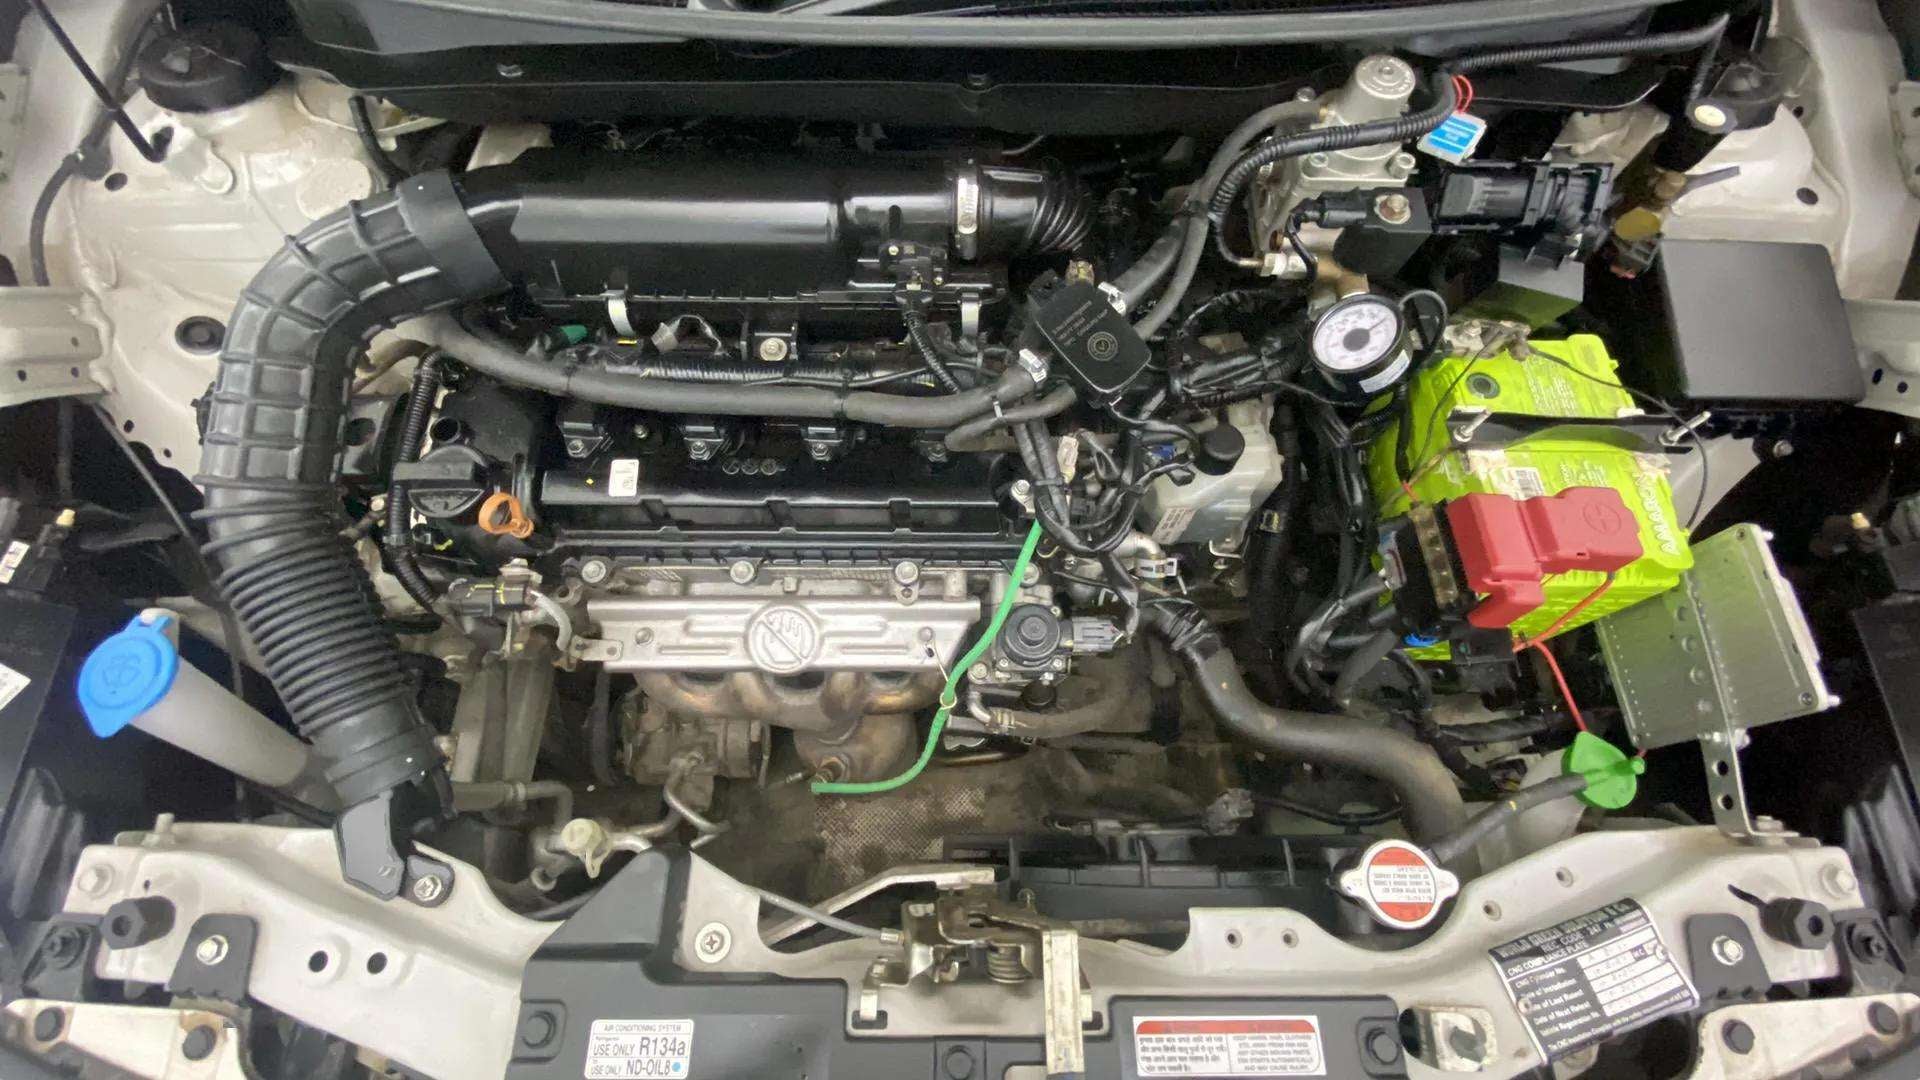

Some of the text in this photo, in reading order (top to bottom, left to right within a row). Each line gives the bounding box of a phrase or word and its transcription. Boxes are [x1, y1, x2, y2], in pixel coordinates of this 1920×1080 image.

[1506, 964, 1523, 976] CNG
[1521, 947, 1568, 970] COMPLIANCE
[1565, 939, 1589, 954] PLATE
[603, 1024, 681, 1032] AIR CONDITIONING SYSTEM
[593, 1036, 686, 1056] USE ONLY R134a
[591, 1065, 604, 1076] USE
[606, 1065, 622, 1075] ONLY
